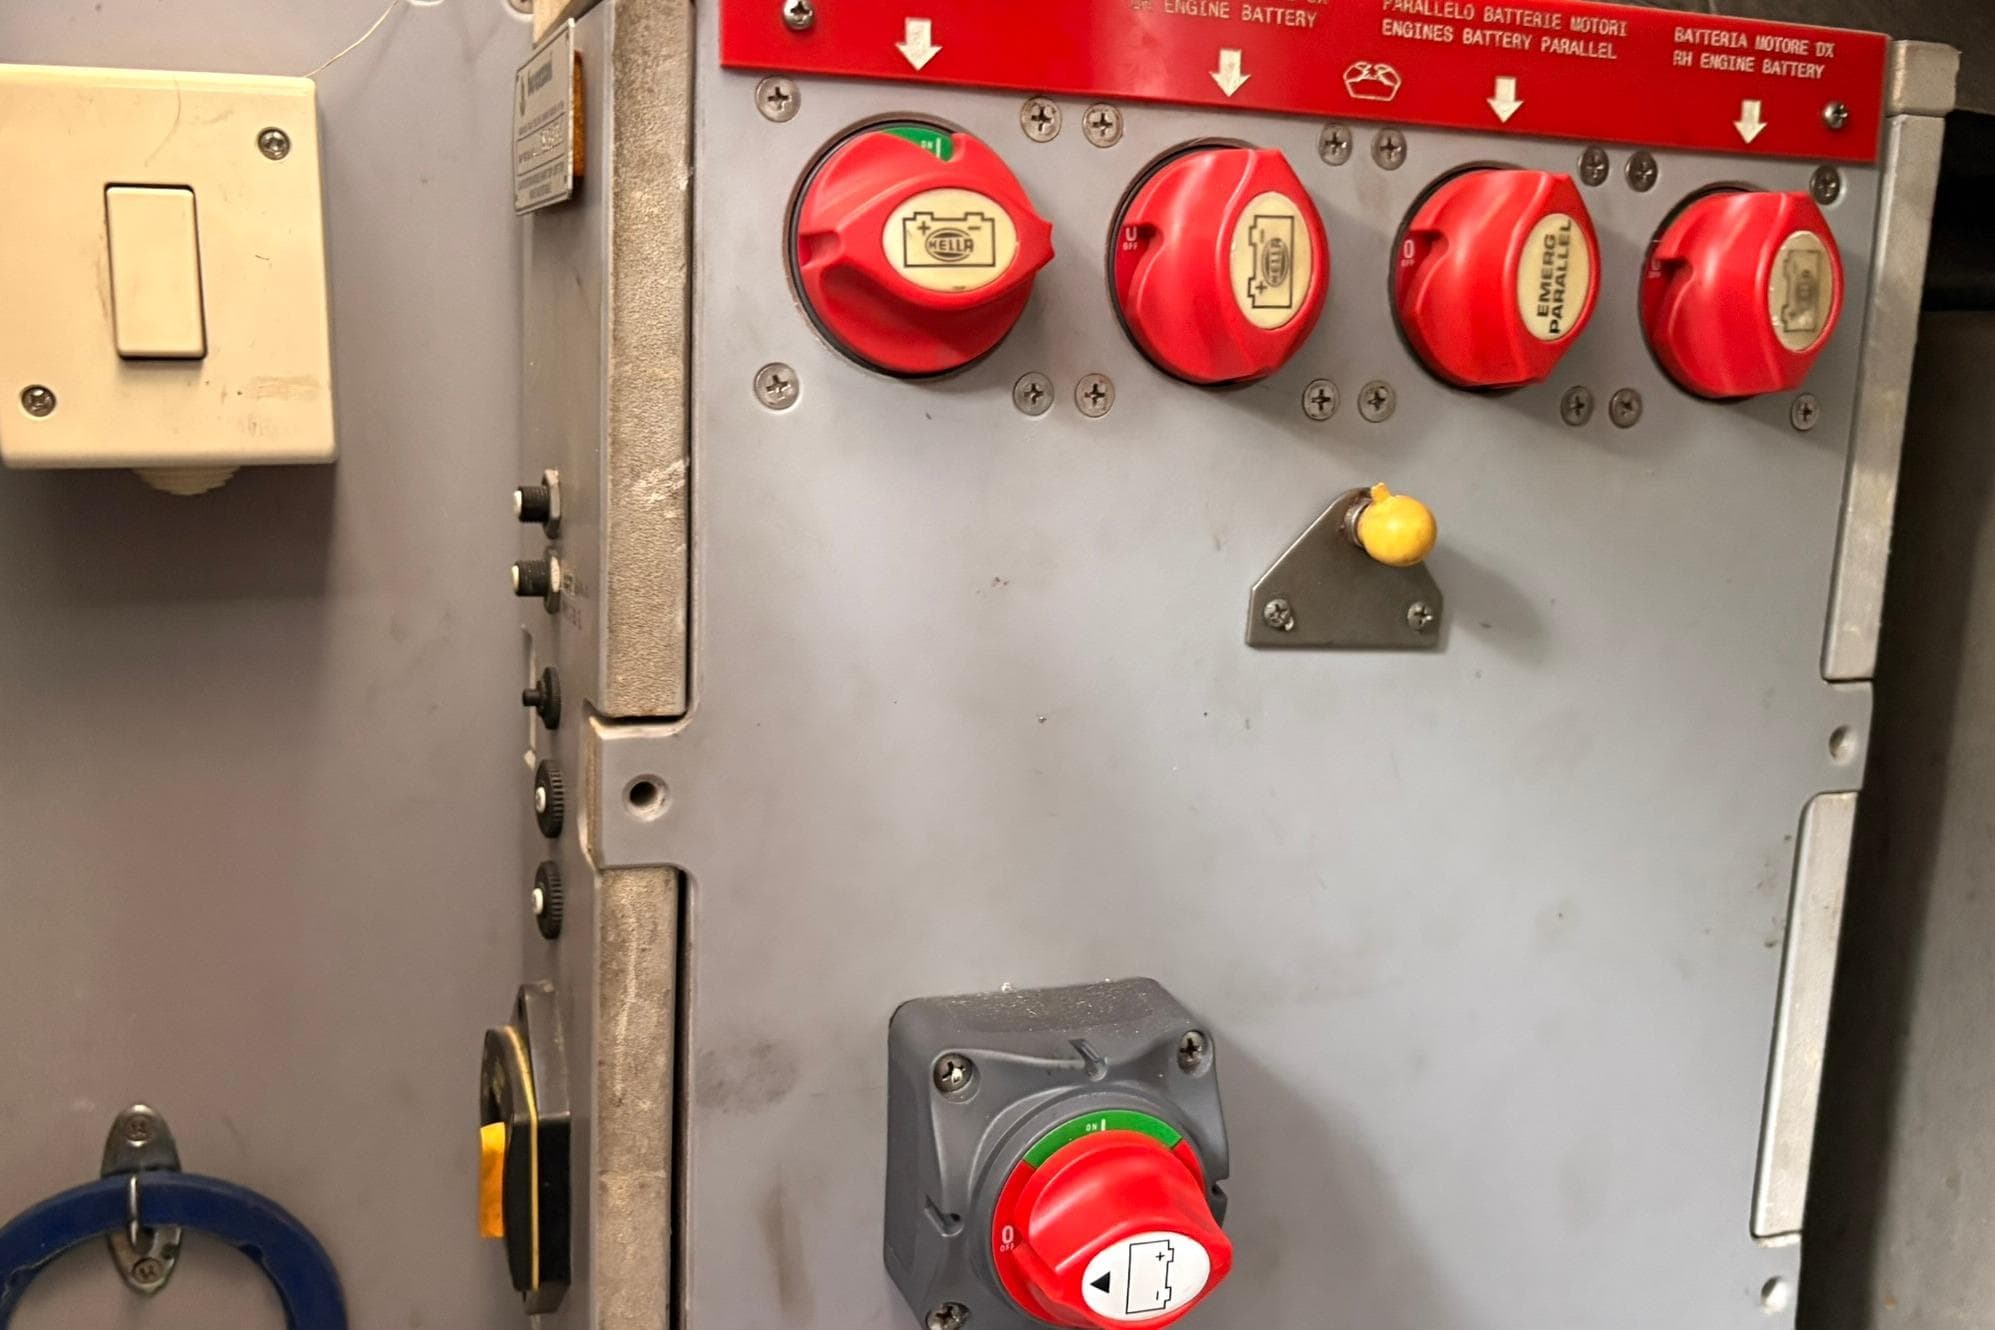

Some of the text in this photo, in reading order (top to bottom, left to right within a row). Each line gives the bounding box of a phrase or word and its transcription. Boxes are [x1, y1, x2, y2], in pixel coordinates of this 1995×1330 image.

[1165, 0, 1230, 19] ENGINE
[1241, 4, 1317, 29] BATTERY
[1383, 0, 1628, 37] PARALLELO BATTERIE MOTORI
[1381, 18, 1617, 60] ENGINES BATTERY PARALLEL
[1673, 26, 1836, 58] BATTERIA MOTORE DX
[1672, 50, 1825, 80] RH ENGINE BATTERY
[927, 237, 974, 253] HELLA
[1536, 233, 1556, 318] EMERG
[1548, 218, 1572, 334] PARALLEL
